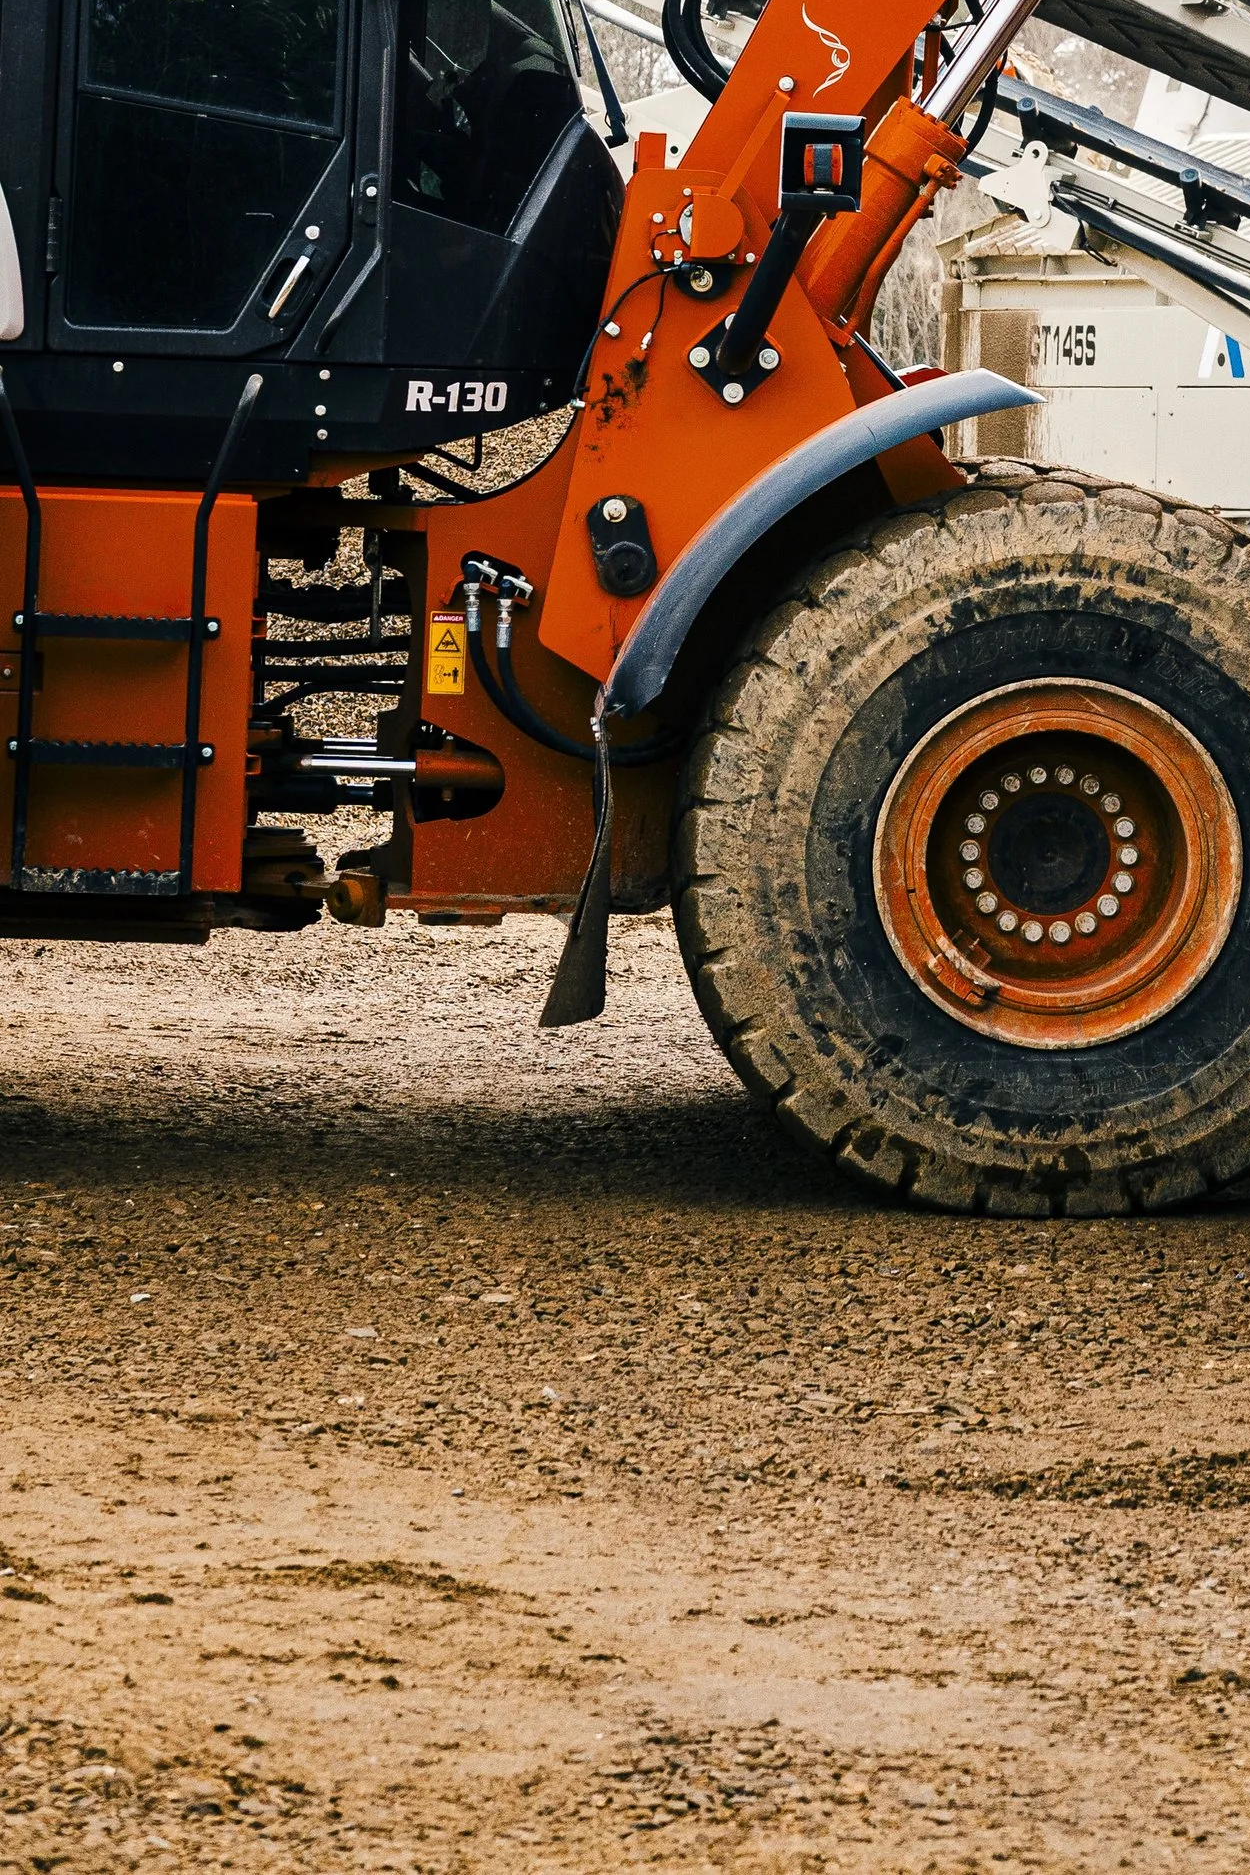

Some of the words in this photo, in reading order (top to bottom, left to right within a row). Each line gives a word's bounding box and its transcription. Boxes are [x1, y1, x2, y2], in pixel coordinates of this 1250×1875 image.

[1030, 325, 1096, 365] GT145S
[405, 380, 508, 413] R-130
[439, 614, 464, 622] DANGER
